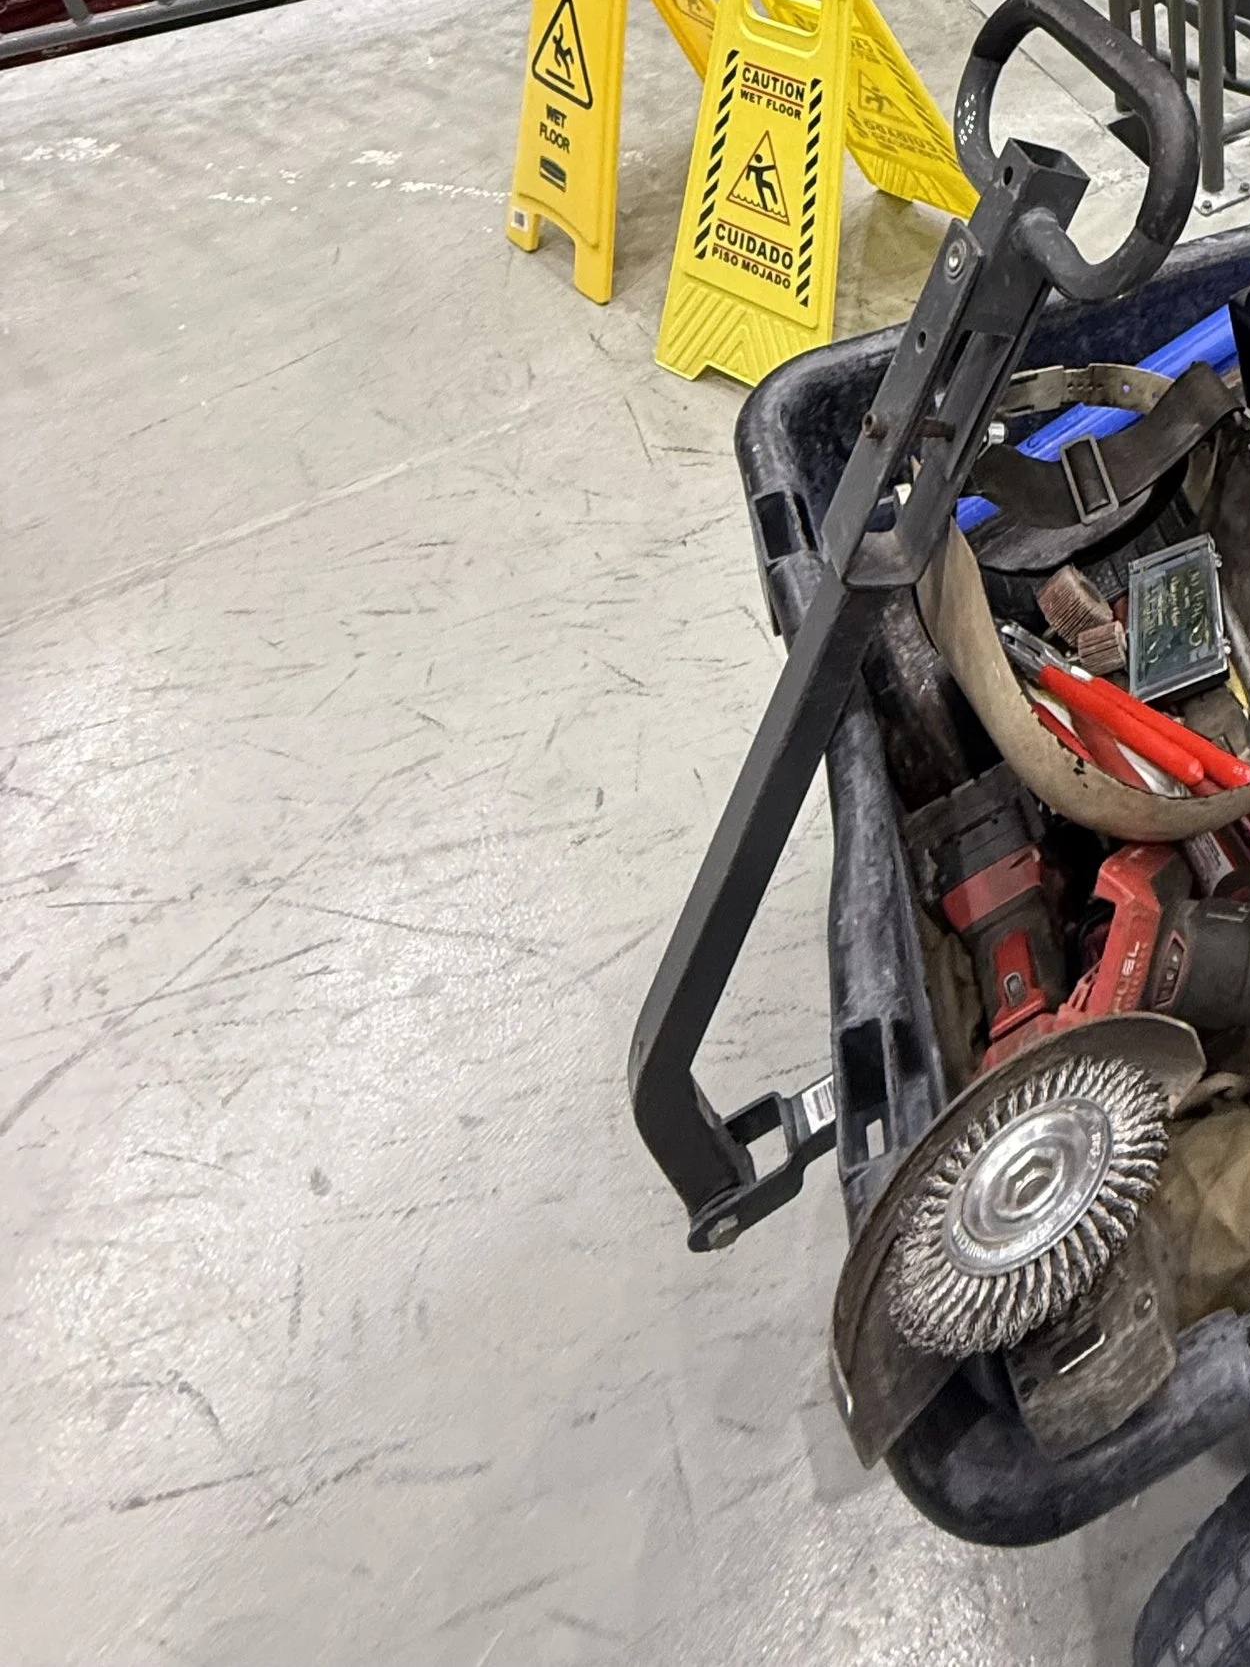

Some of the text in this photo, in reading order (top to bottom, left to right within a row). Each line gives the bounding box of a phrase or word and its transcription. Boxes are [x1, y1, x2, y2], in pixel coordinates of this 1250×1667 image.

[742, 66, 805, 103] CAUTION
[546, 103, 567, 130] WET
[740, 88, 802, 121] WET FLOOR
[539, 121, 571, 155] FLOOR
[715, 222, 793, 270] CUIDADO
[712, 245, 791, 290] PISO MOJADO
